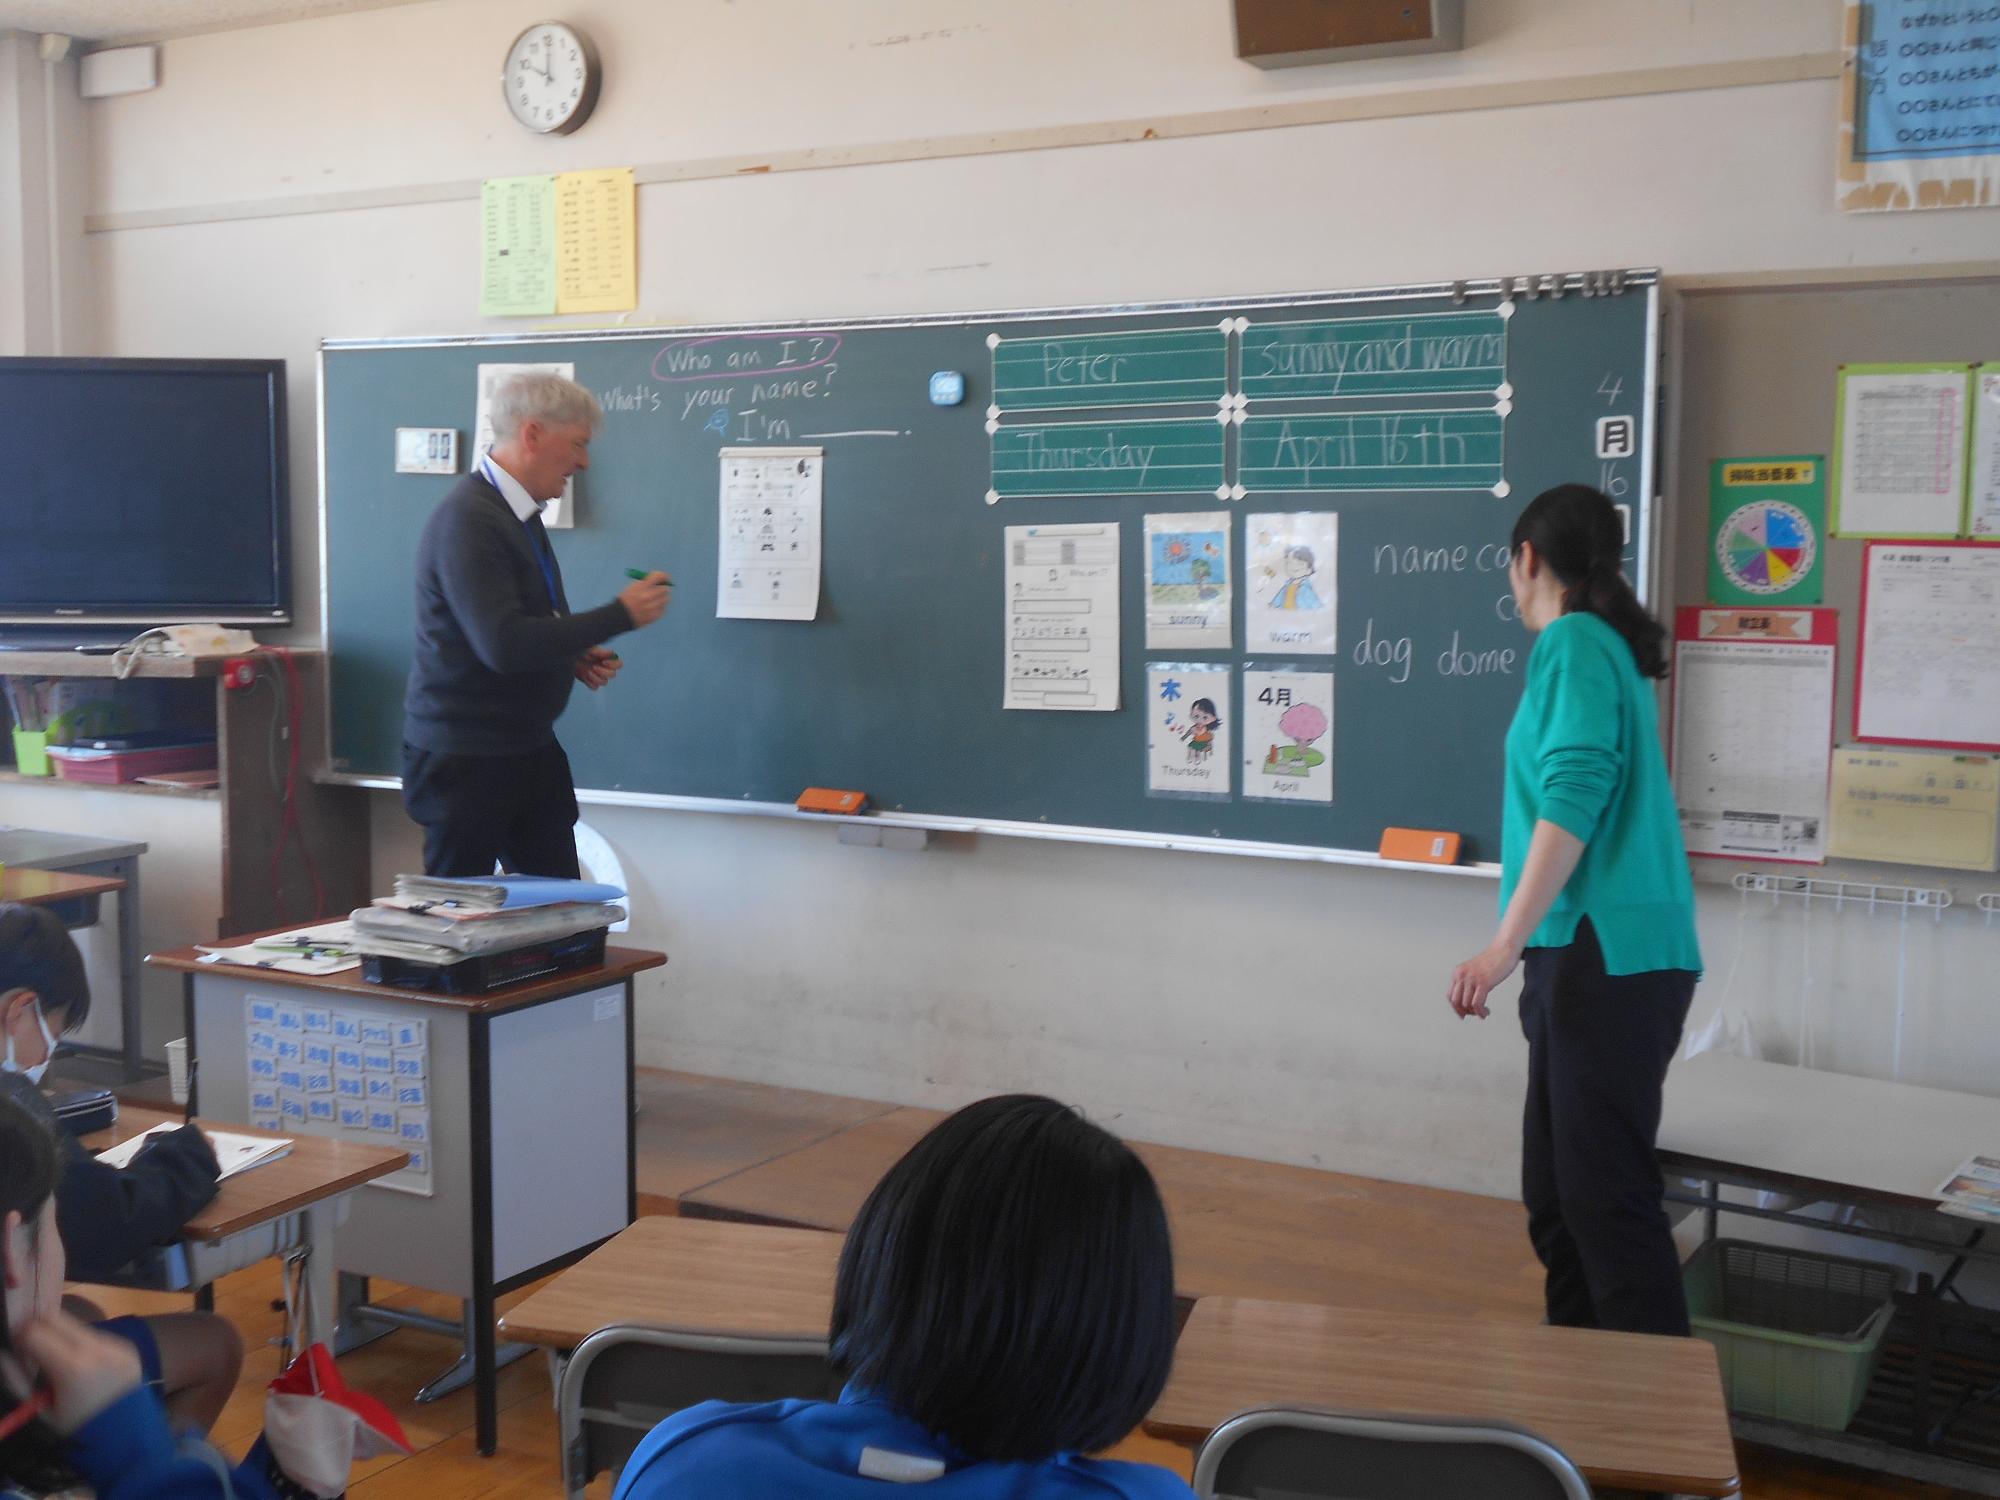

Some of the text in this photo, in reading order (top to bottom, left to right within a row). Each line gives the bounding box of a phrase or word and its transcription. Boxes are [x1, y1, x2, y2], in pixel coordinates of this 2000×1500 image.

[667, 347, 711, 373] Who
[727, 352, 762, 367] am
[1043, 342, 1127, 386] Peter
[1354, 325, 1411, 373] and
[1422, 334, 1500, 371] warm
[599, 363, 837, 421] What's your name?
[1597, 371, 1623, 406] 4
[736, 409, 790, 442] I'm
[1602, 420, 1628, 454] 月
[1016, 430, 1155, 487] Thursday
[1274, 416, 1357, 487] April
[1600, 462, 1629, 496] 16
[1374, 544, 1468, 575] name
[1169, 615, 1208, 628] sunny
[1270, 632, 1312, 643] warm
[1353, 618, 1516, 683] dog dome
[1160, 678, 1181, 701] 木
[1258, 687, 1291, 706] 4月
[1162, 765, 1211, 778] Thursday
[1273, 781, 1299, 793] April
